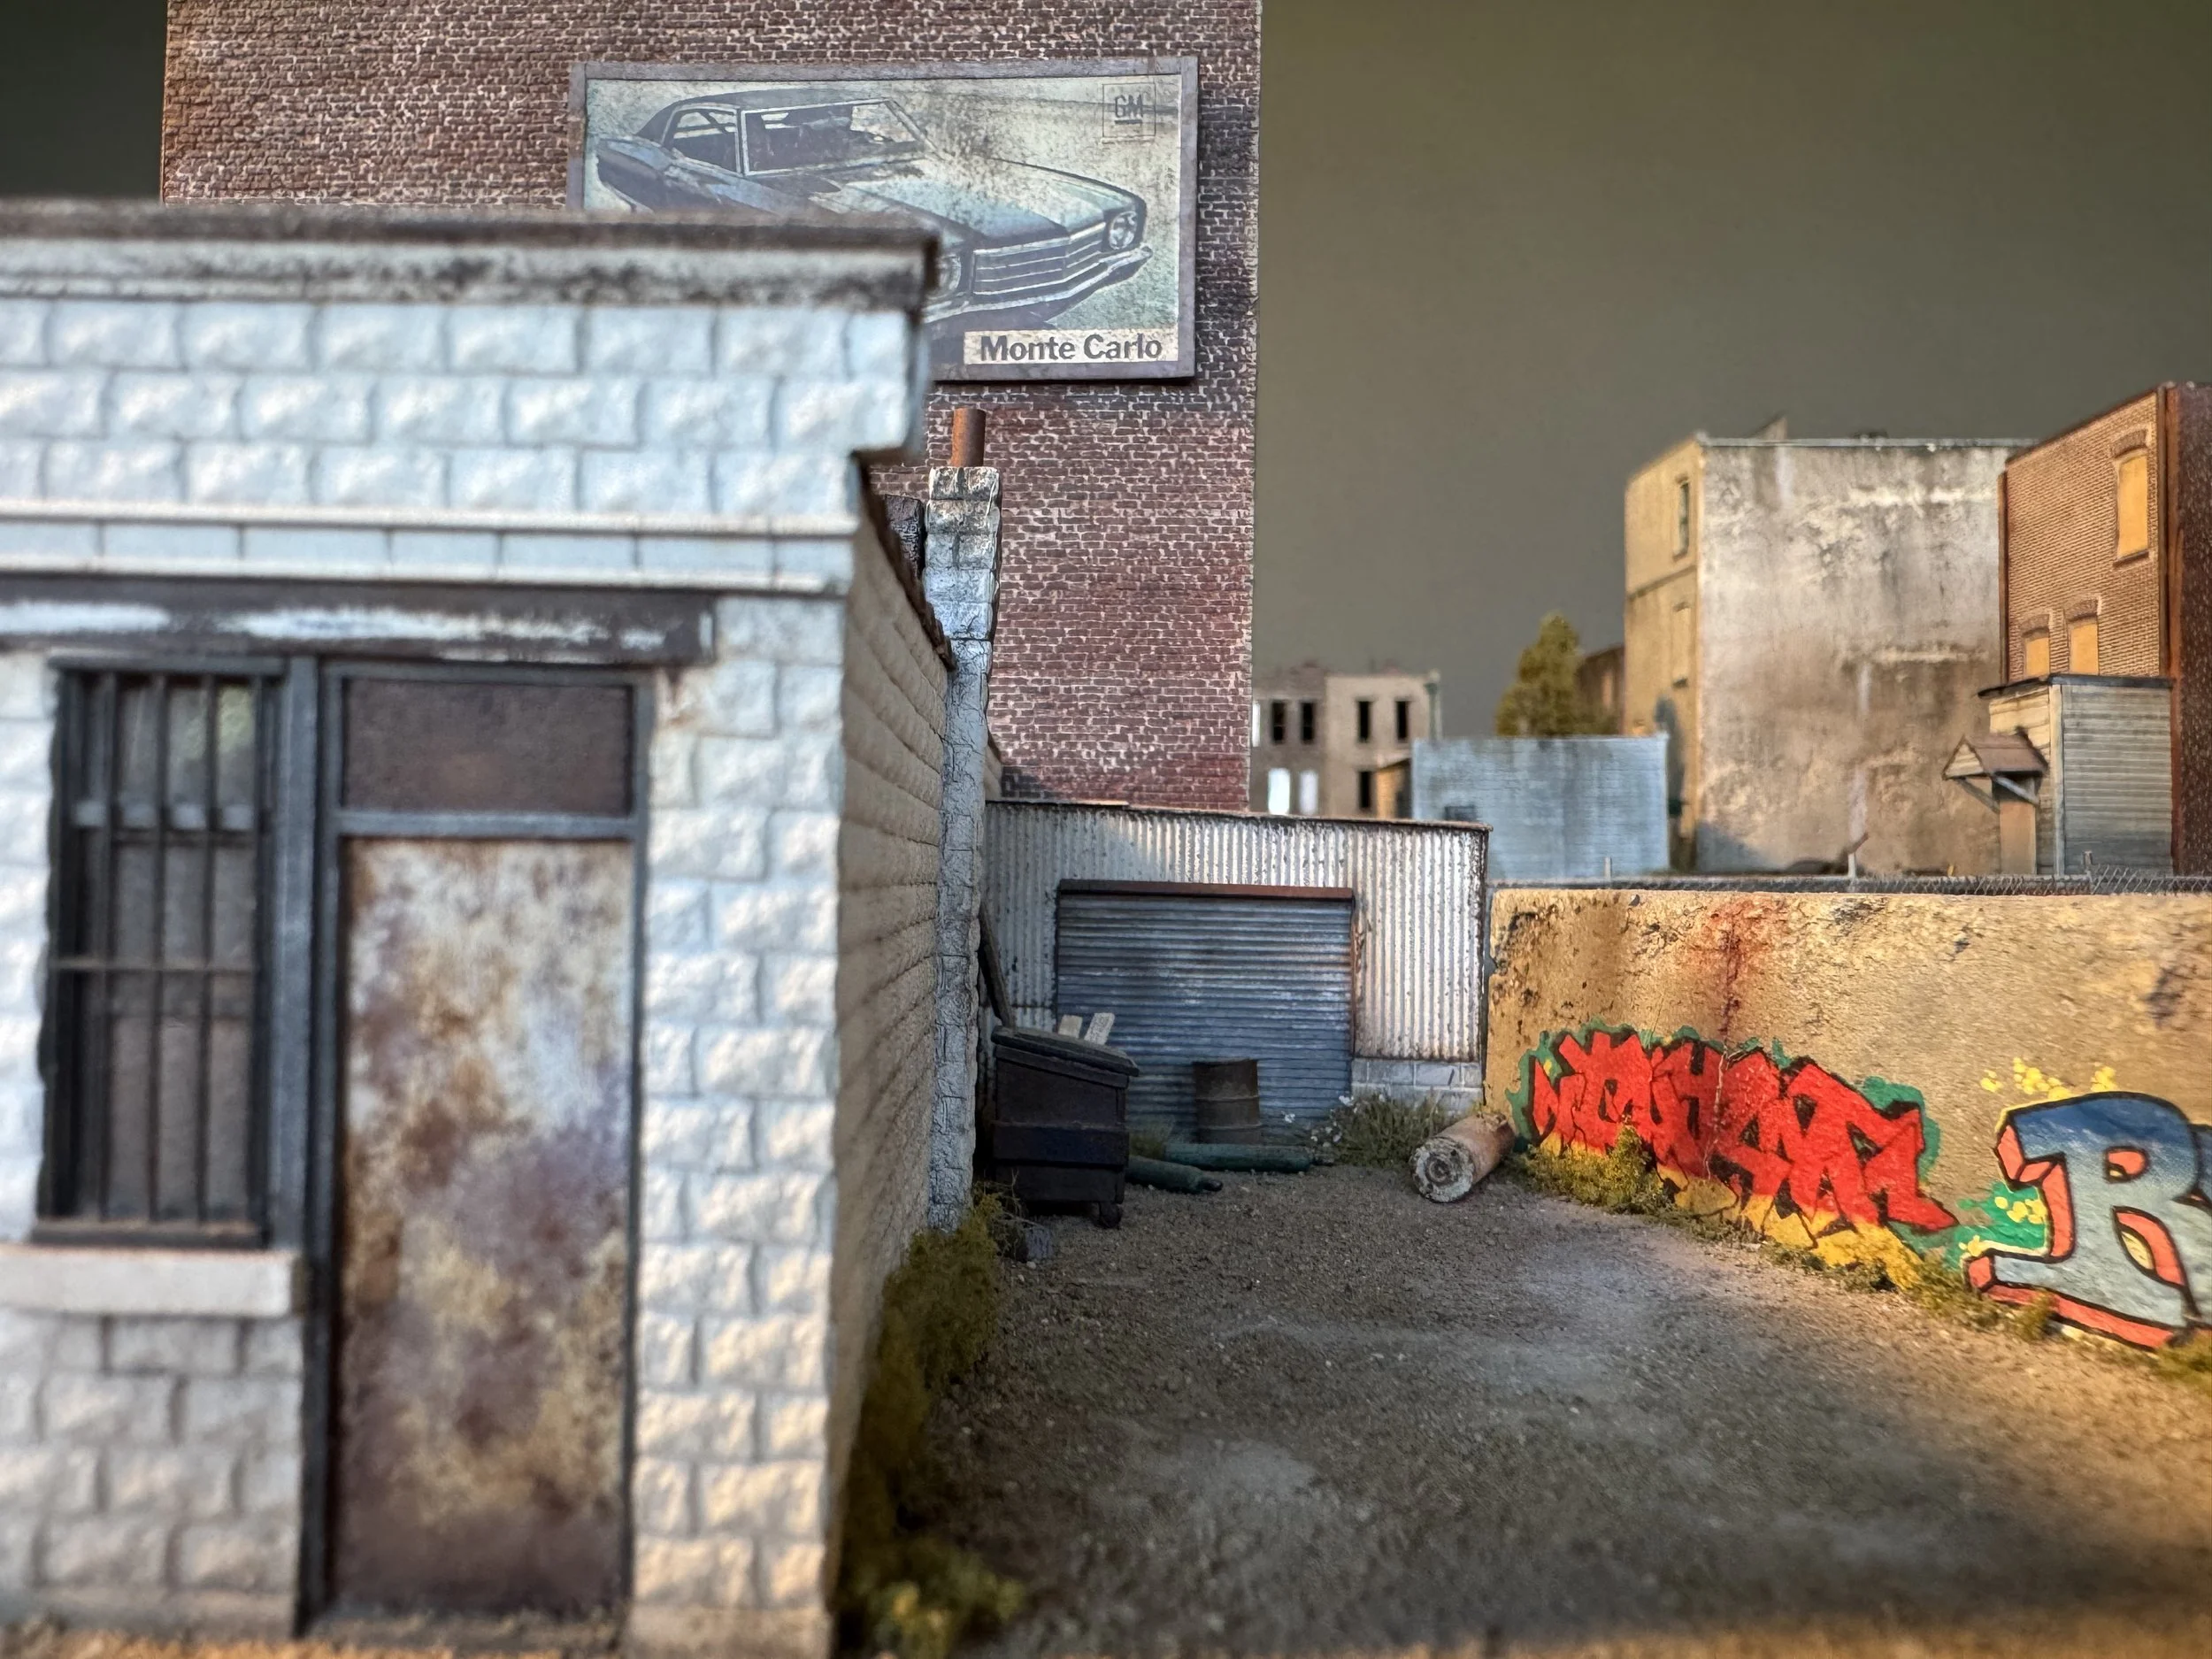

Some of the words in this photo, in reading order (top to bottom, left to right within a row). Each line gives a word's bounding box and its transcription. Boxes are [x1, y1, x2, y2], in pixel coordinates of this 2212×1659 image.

[1114, 94, 1143, 118] GM
[980, 335, 1075, 362] Monte
[1083, 333, 1163, 359] Carlo
